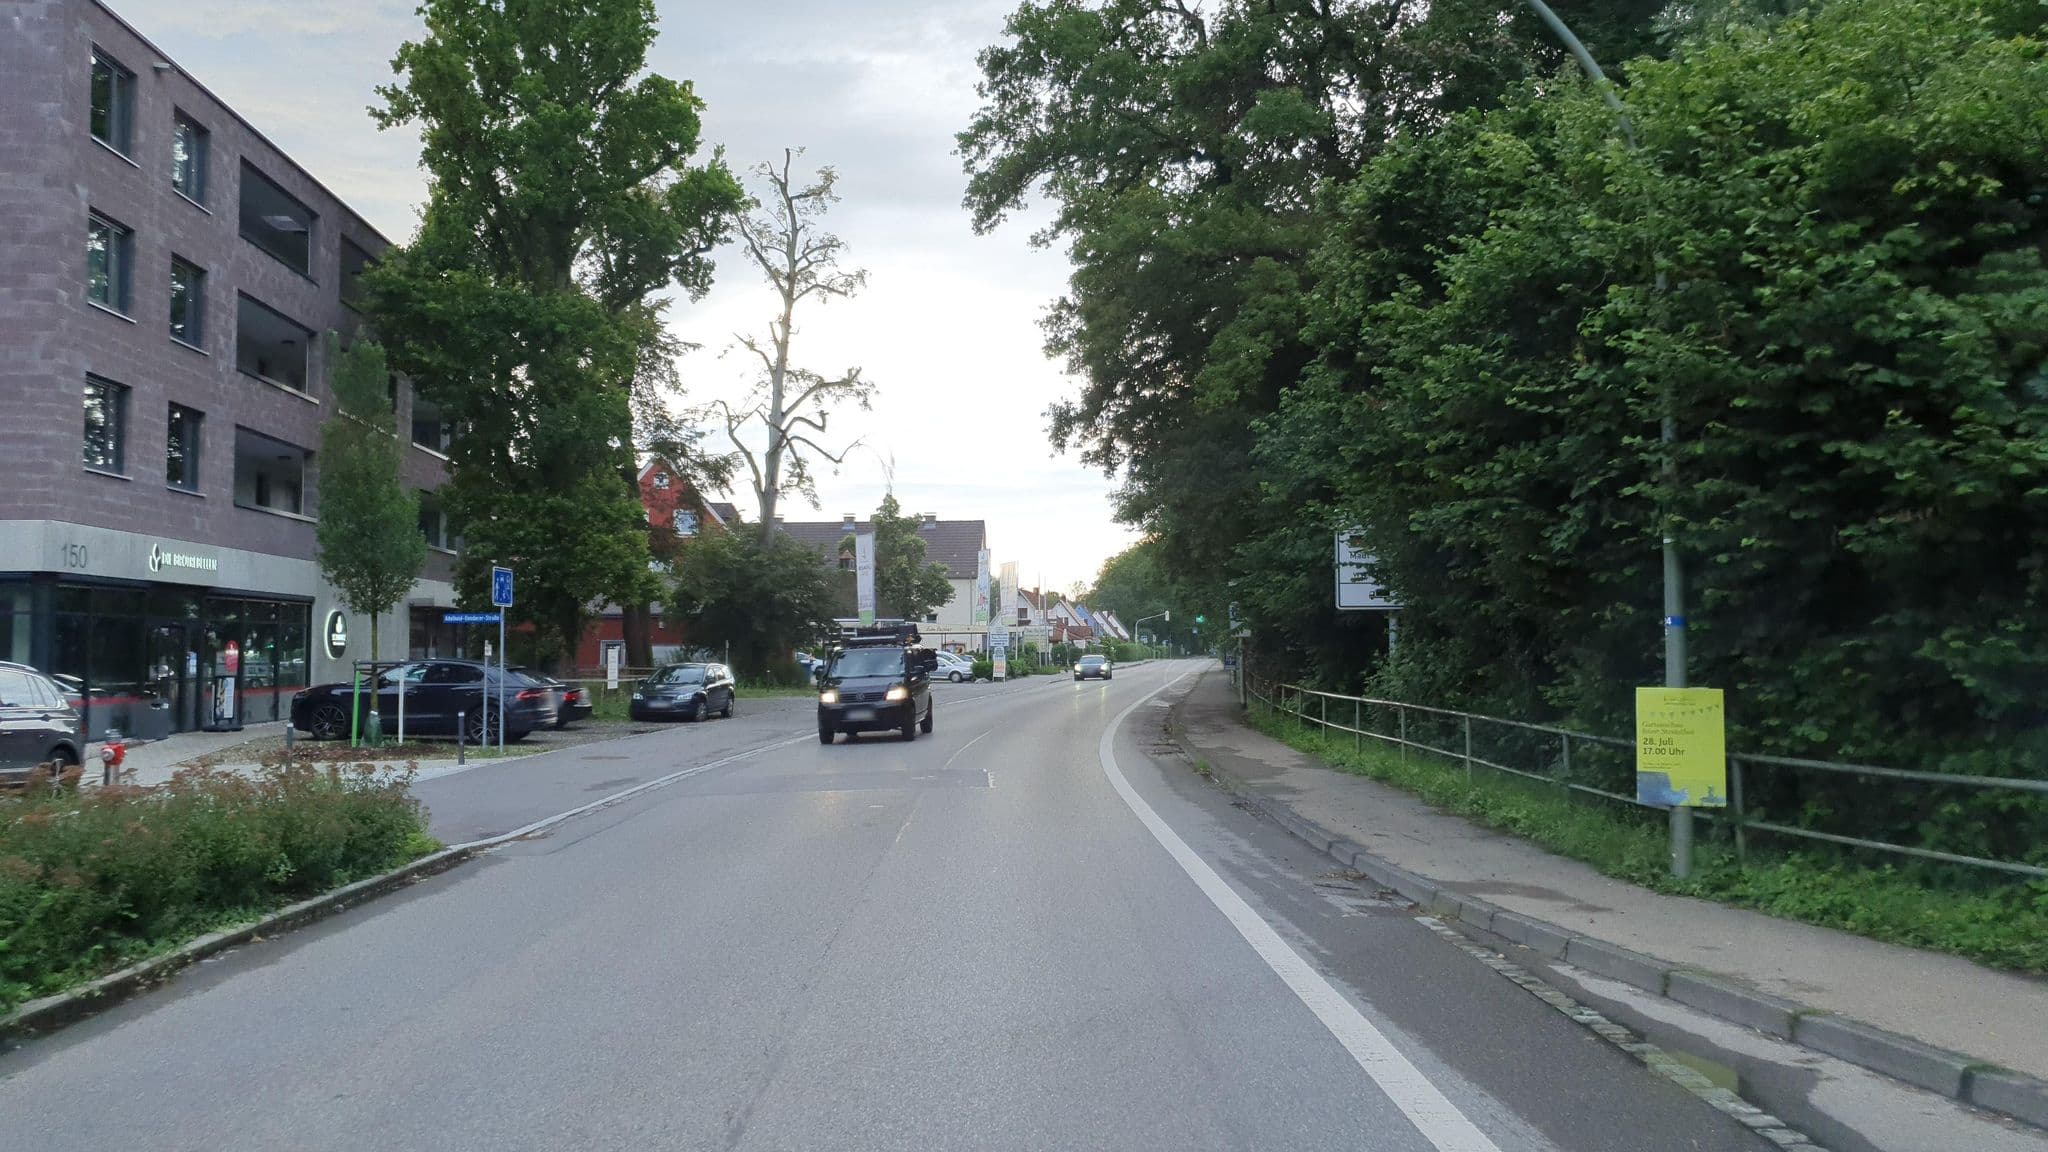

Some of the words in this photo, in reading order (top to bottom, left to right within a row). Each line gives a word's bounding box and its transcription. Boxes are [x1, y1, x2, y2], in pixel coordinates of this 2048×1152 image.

[61, 544, 88, 569] 150
[1642, 737, 1658, 746] 28.
[1658, 737, 1674, 747] Juli
[1642, 747, 1667, 755] 17.00
[1668, 747, 1687, 756] Uhr
